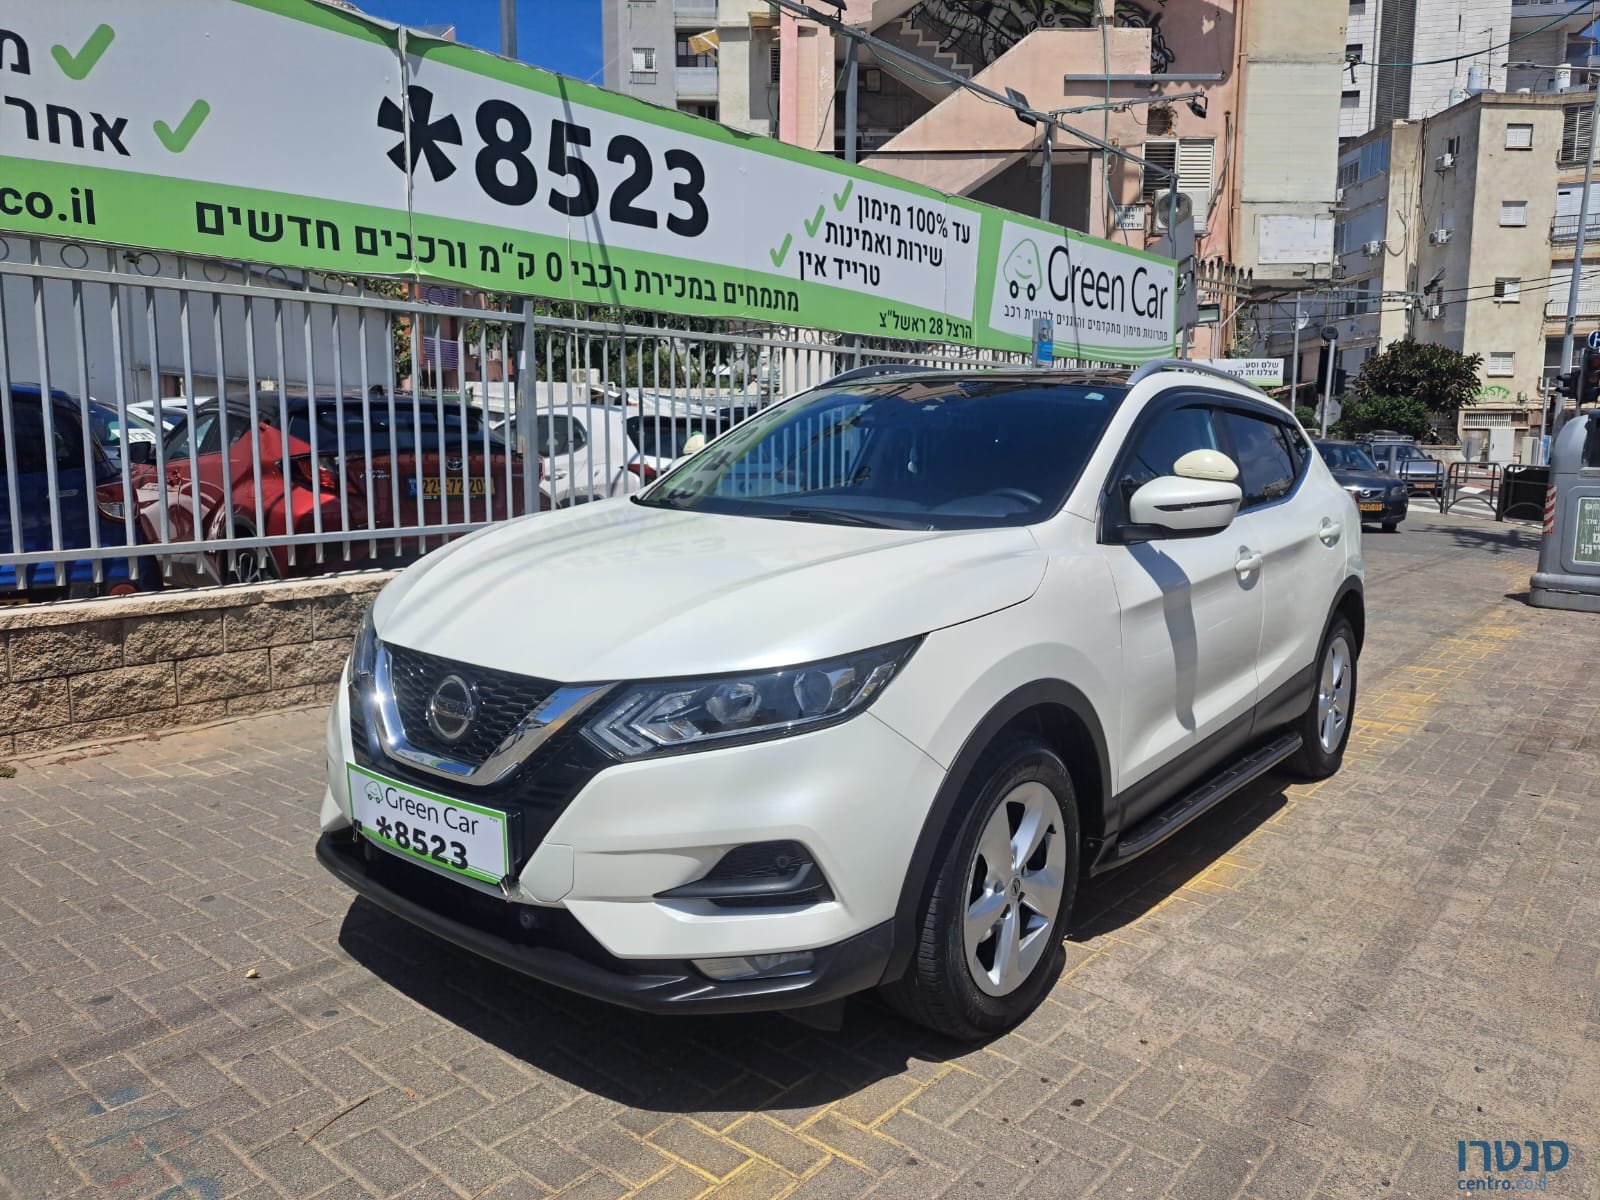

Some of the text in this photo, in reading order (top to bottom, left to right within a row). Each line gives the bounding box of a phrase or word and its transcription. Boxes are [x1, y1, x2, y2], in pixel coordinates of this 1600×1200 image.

[4, 95, 131, 157] אחר
[858, 195, 970, 244] עד 100% מימון
[196, 201, 799, 312] מתמחים במכירת רכבי 0 ק"מ ורכבים חדשים
[825, 221, 943, 267] שירות ואמינות
[799, 251, 880, 286] טרייד אין
[1048, 245, 1168, 320] Green Car
[879, 309, 972, 339] הרצל 28 ראשל"צ
[1004, 305, 1021, 319] רכב
[1088, 319, 1121, 335] מתקדמים
[1123, 324, 1141, 338] מימון
[1142, 328, 1168, 341] פתרונות
[385, 787, 479, 835] Green Car
